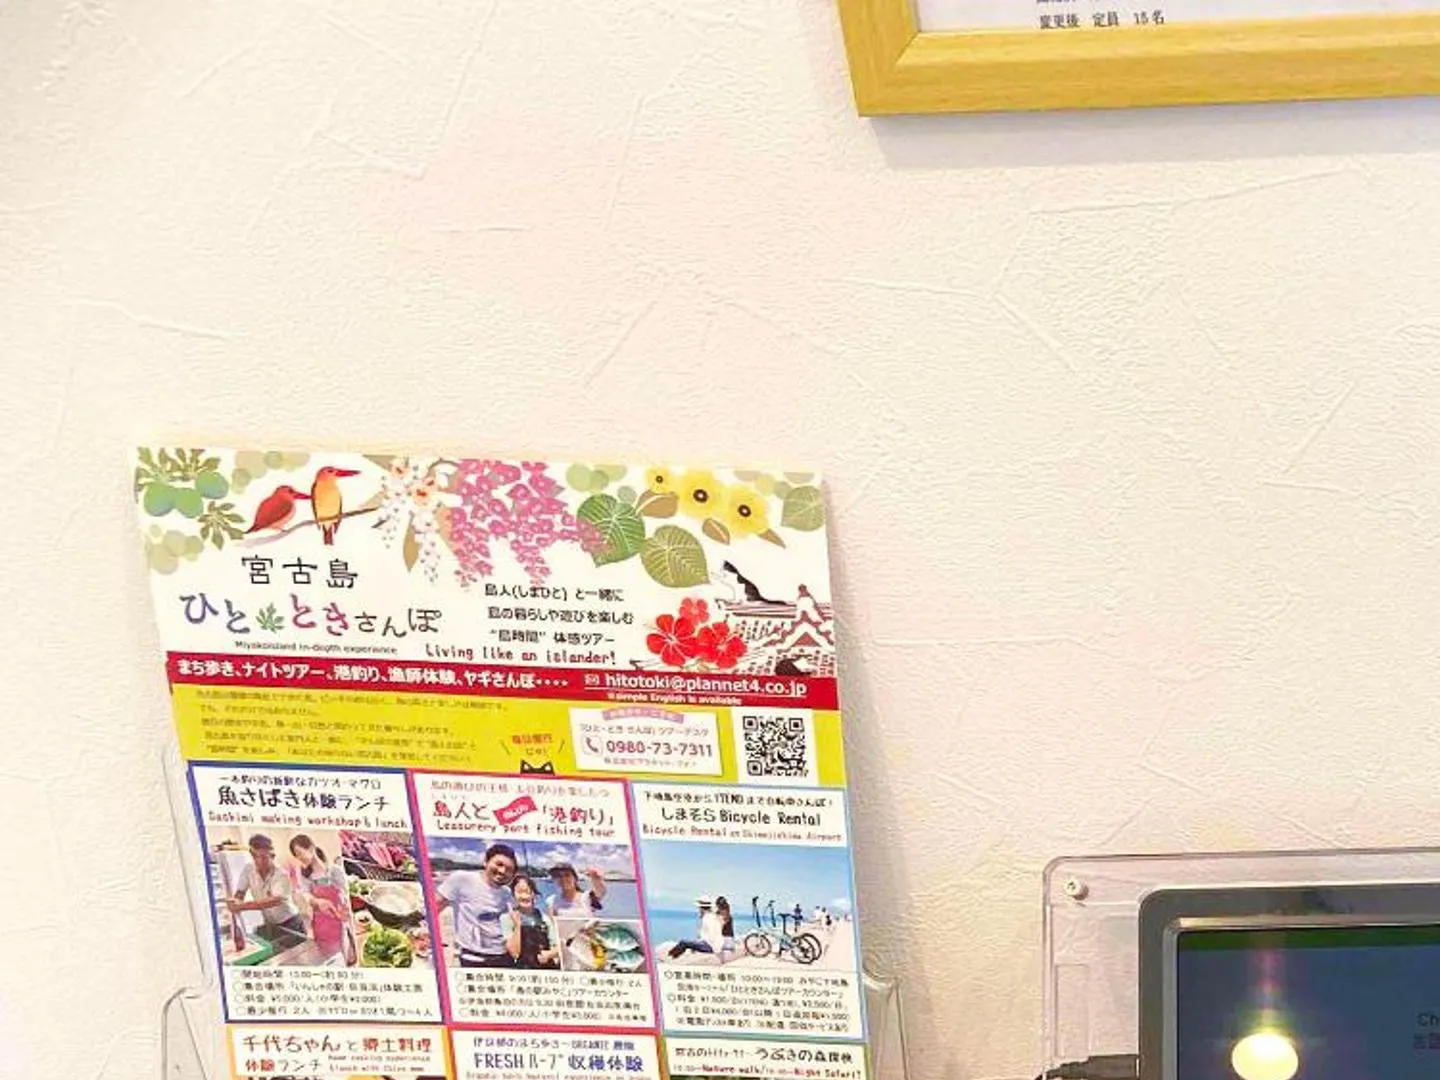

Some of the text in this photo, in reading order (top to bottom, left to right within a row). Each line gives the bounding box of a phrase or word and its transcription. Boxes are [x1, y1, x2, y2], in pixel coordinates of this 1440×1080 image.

[241, 554, 358, 588] 宮古島
[425, 643, 474, 660] Living
[483, 646, 513, 660] like
[521, 653, 537, 661] an
[605, 673, 807, 697] hitotoki@plannet4.co.jp
[606, 739, 713, 758] 0980-73-7311
[719, 807, 771, 825] Bicycle
[777, 811, 822, 827] Rental
[473, 1053, 524, 1070] FRESH
